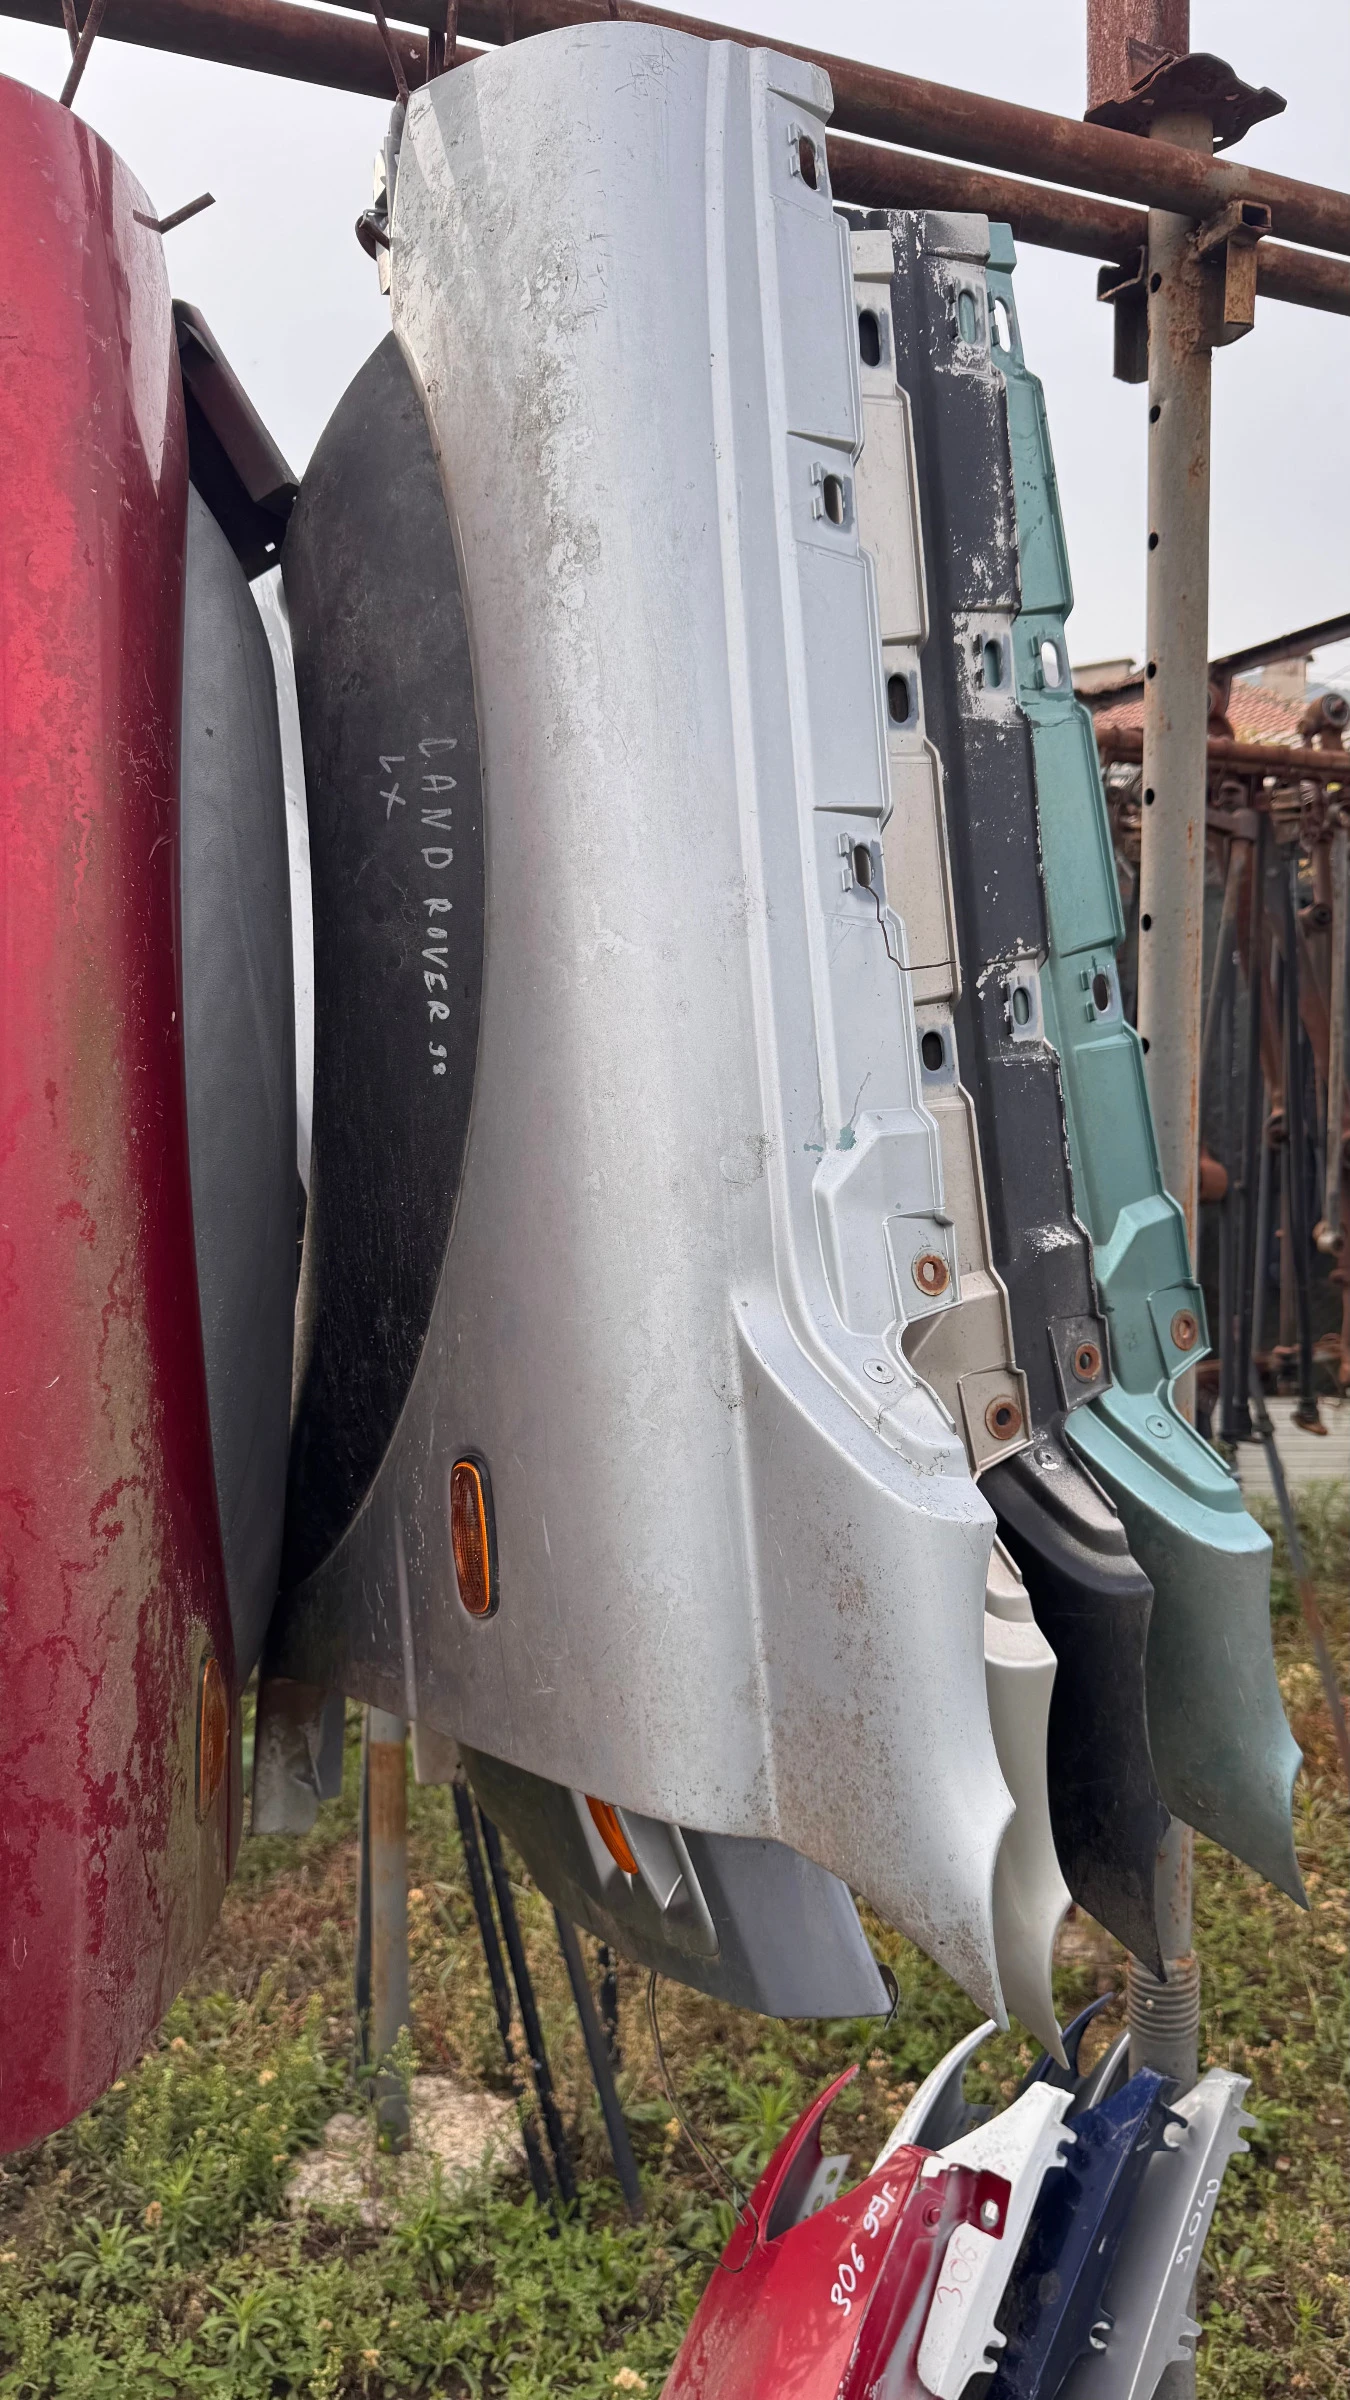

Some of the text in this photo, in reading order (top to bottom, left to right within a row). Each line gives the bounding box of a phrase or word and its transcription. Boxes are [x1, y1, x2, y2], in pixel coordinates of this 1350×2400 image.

[378, 755, 407, 820] LX
[418, 737, 458, 870] LAND
[421, 897, 454, 1023] ROVER
[830, 2243, 866, 2317] 306
[936, 2237, 980, 2307] 306
